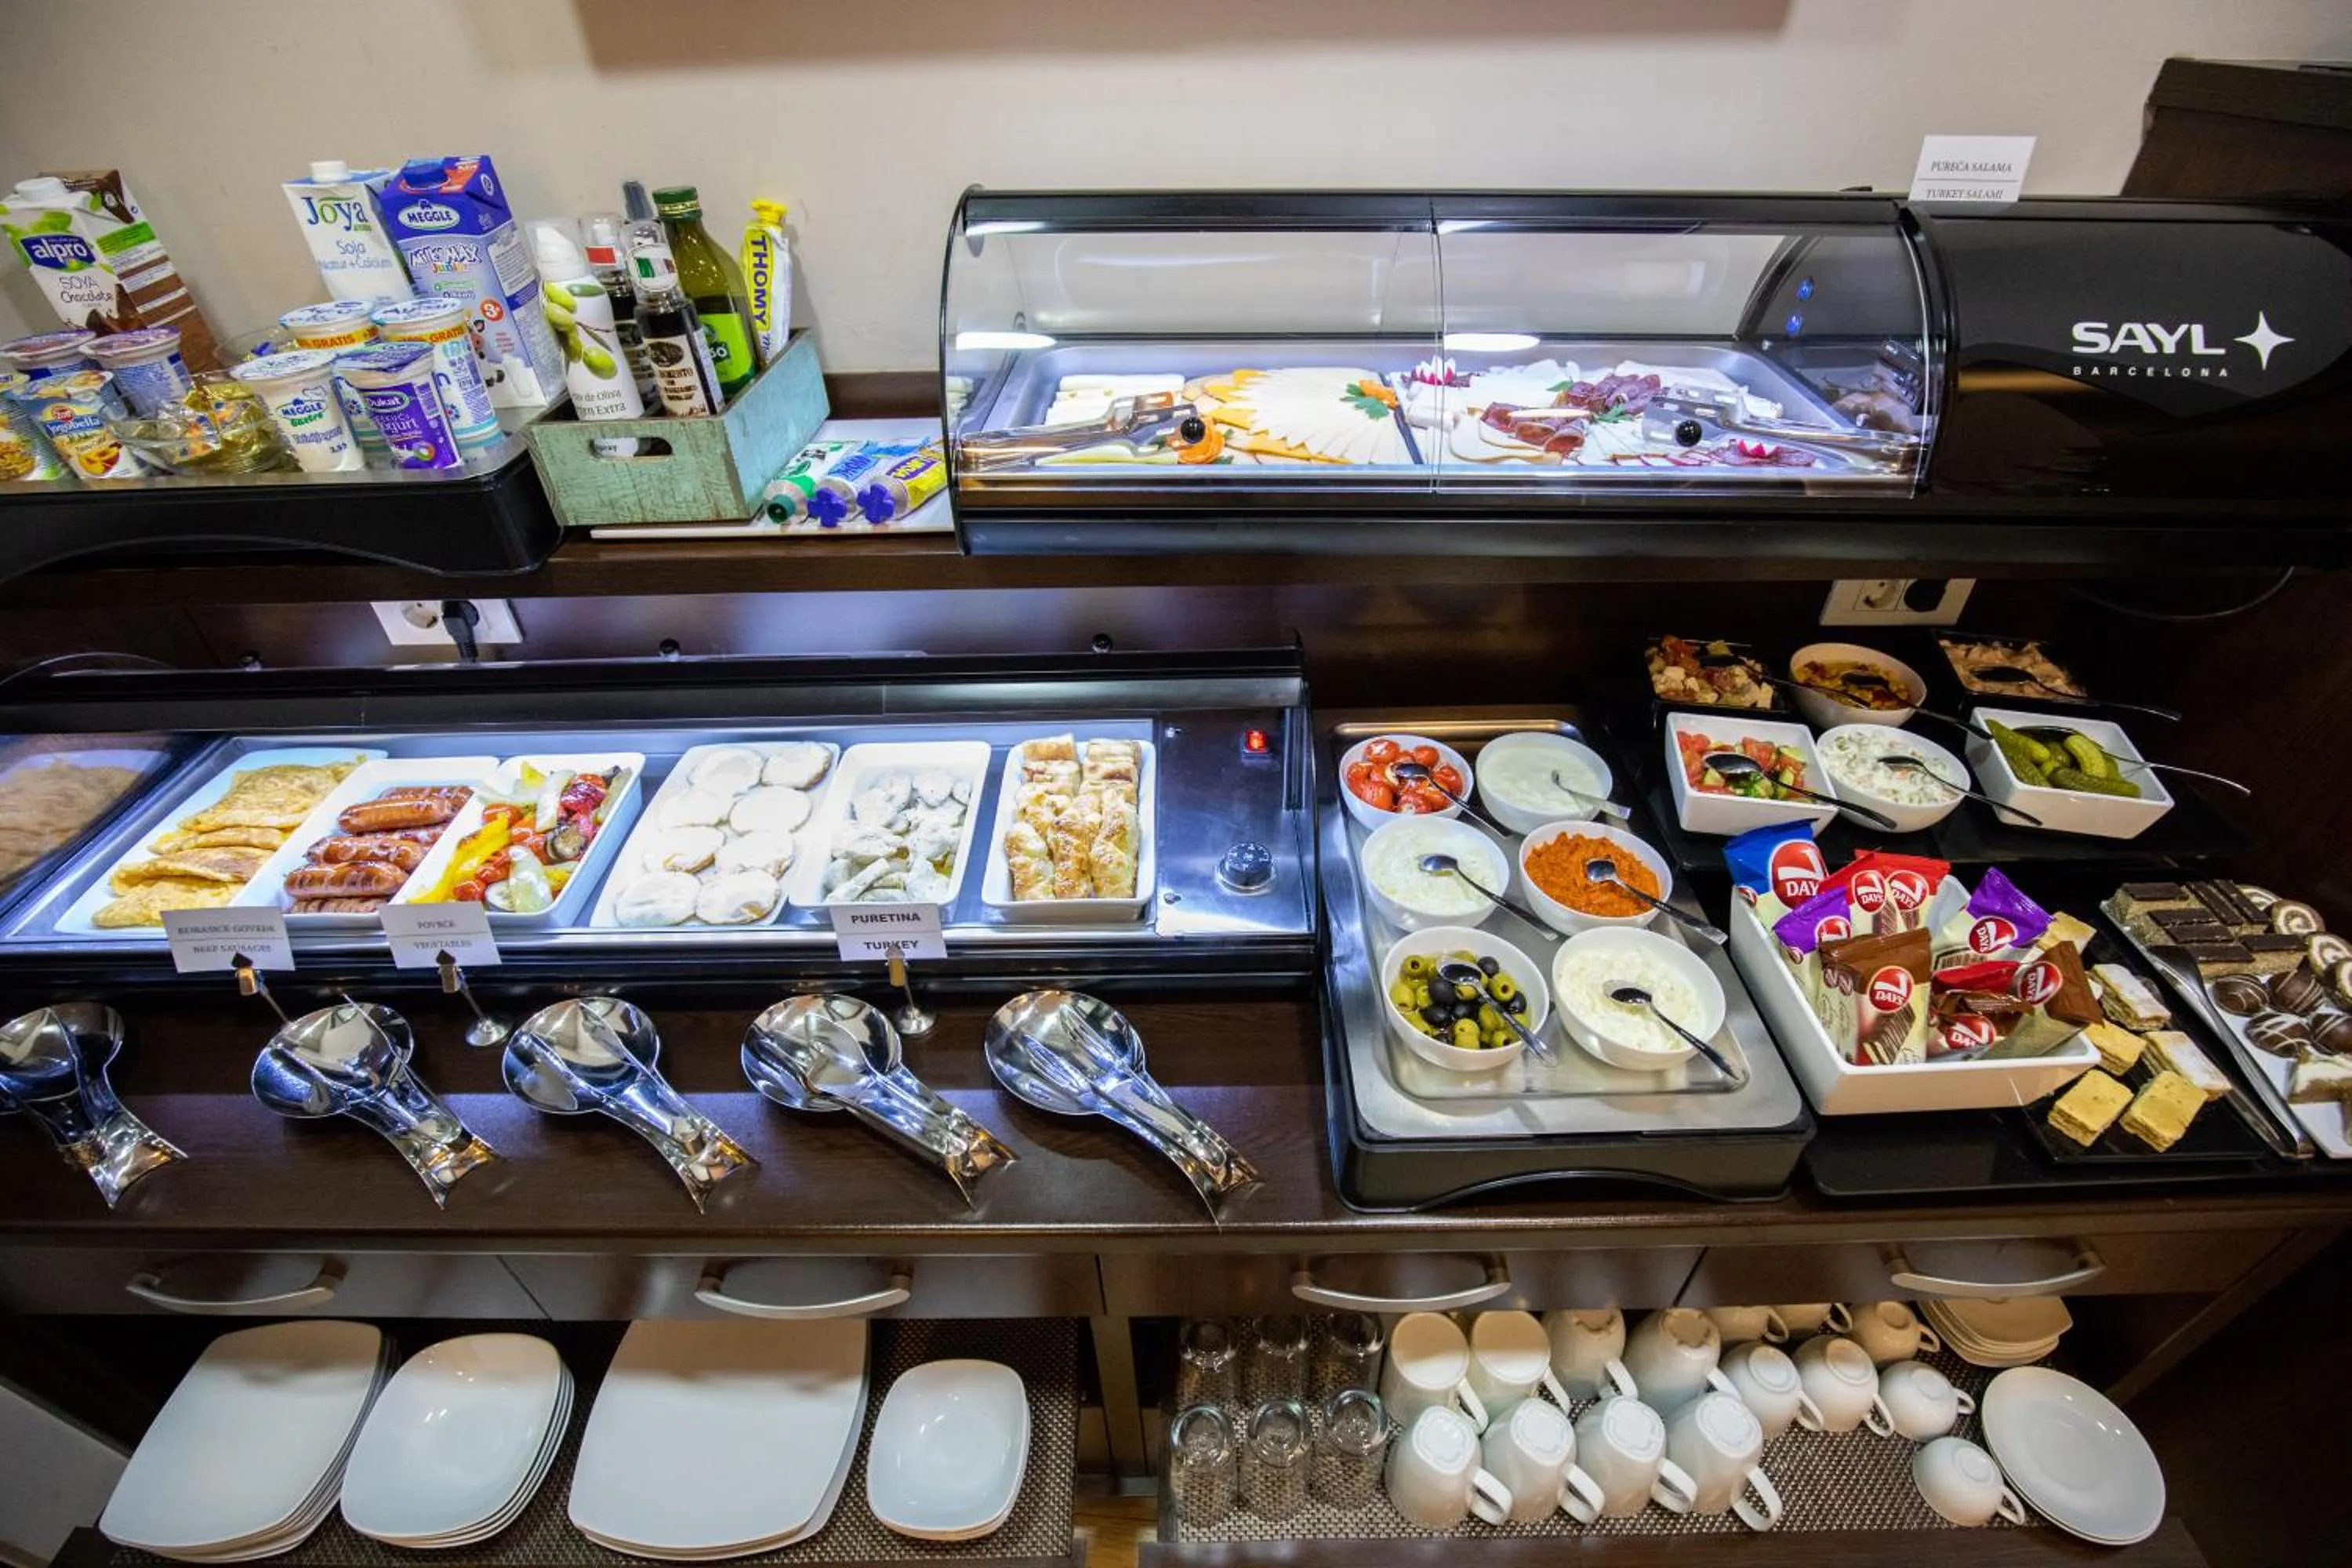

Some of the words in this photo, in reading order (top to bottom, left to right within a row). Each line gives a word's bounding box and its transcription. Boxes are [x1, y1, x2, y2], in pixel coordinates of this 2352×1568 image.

[1970, 162, 2013, 172] SALAMA
[1926, 189, 1963, 199] TURKEY
[300, 195, 369, 232] Joya
[407, 209, 453, 223] MEGGLE
[31, 238, 88, 264] alpro
[751, 234, 768, 326] THOMY
[312, 334, 356, 349] GRATIS
[2071, 321, 2227, 355] SAYL
[2072, 366, 2228, 377] BARCELONA
[596, 402, 627, 415] Extra
[1785, 880, 1820, 897] DAY
[1861, 893, 1885, 905] DAYS
[1892, 887, 1916, 909] DAYS
[850, 913, 921, 924] PURETINA
[863, 940, 919, 951] TURKEY
[1873, 971, 1908, 997] 7
[1875, 990, 1905, 1005] DAYS
